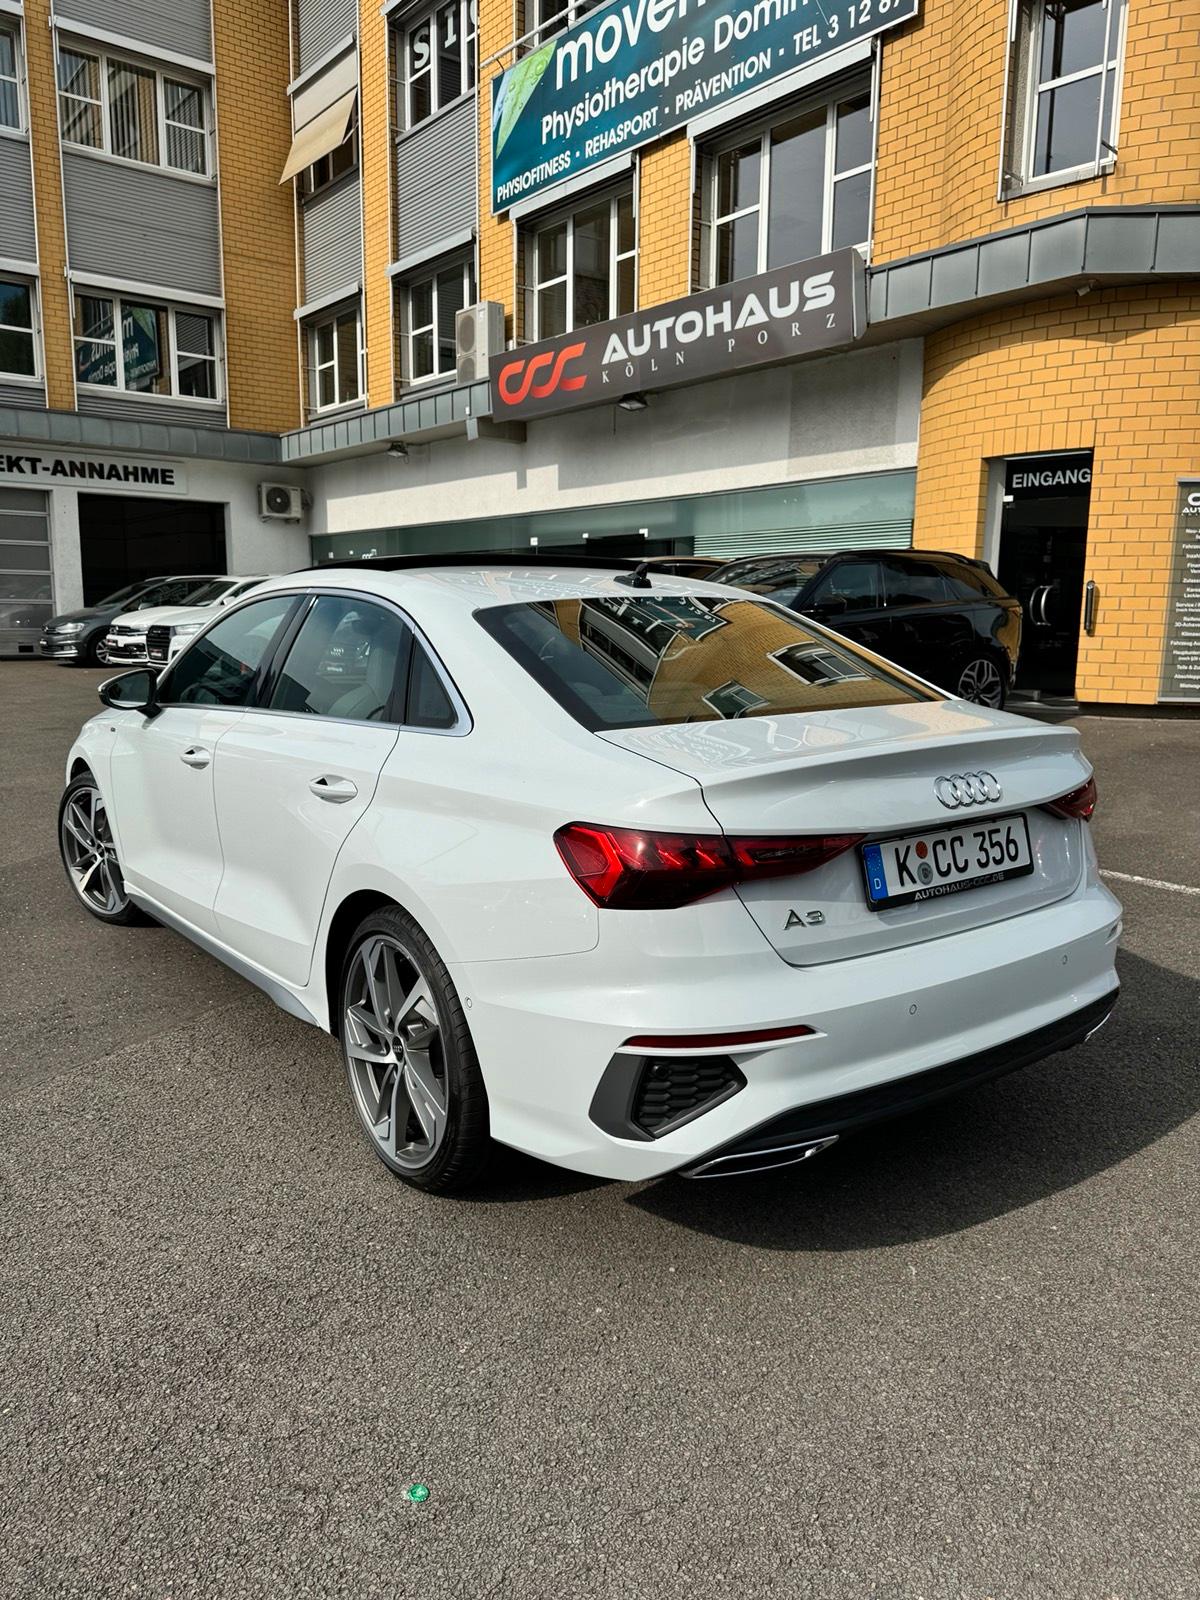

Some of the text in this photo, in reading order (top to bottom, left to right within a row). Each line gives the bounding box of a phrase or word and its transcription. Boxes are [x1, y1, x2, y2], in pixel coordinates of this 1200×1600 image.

[497, 151, 571, 203] PHYSIOFITNESS
[585, 106, 659, 158] REHASPORT
[675, 48, 771, 115] PRÄVENTION
[793, 24, 822, 55] TEL
[827, 14, 839, 39] 3
[848, 0, 871, 29] 12
[541, 36, 705, 145] Physiotherapie
[601, 271, 836, 365] AUTOHAUS
[728, 313, 836, 353] PORZ
[1012, 468, 1091, 488] EINGANG
[873, 826, 1019, 890] D K CC 356
[783, 909, 825, 930] A3
